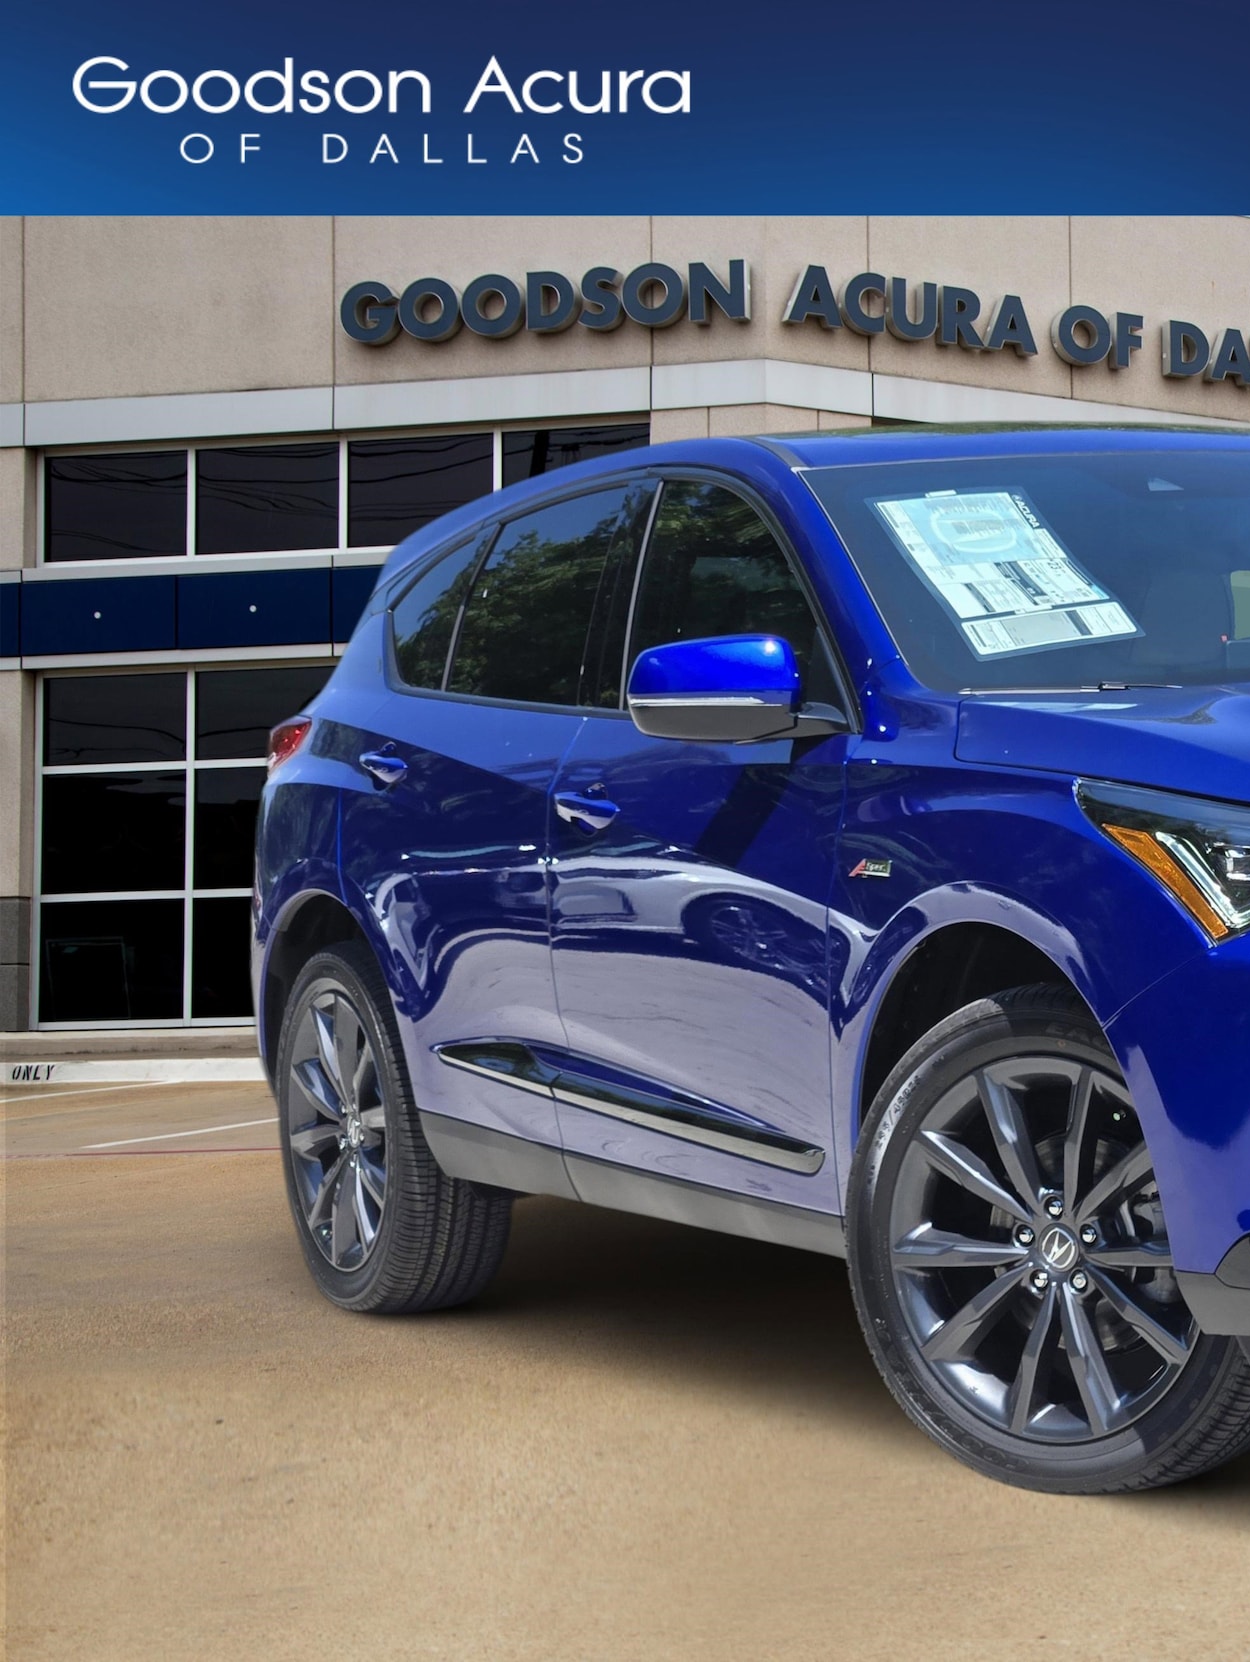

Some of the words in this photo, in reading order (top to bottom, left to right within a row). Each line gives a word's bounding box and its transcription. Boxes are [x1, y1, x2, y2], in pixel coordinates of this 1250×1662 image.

[340, 259, 751, 346] GOODSON
[782, 264, 1037, 356] ACURA
[1051, 304, 1144, 371] OF
[12, 1065, 55, 1080] ONLY
